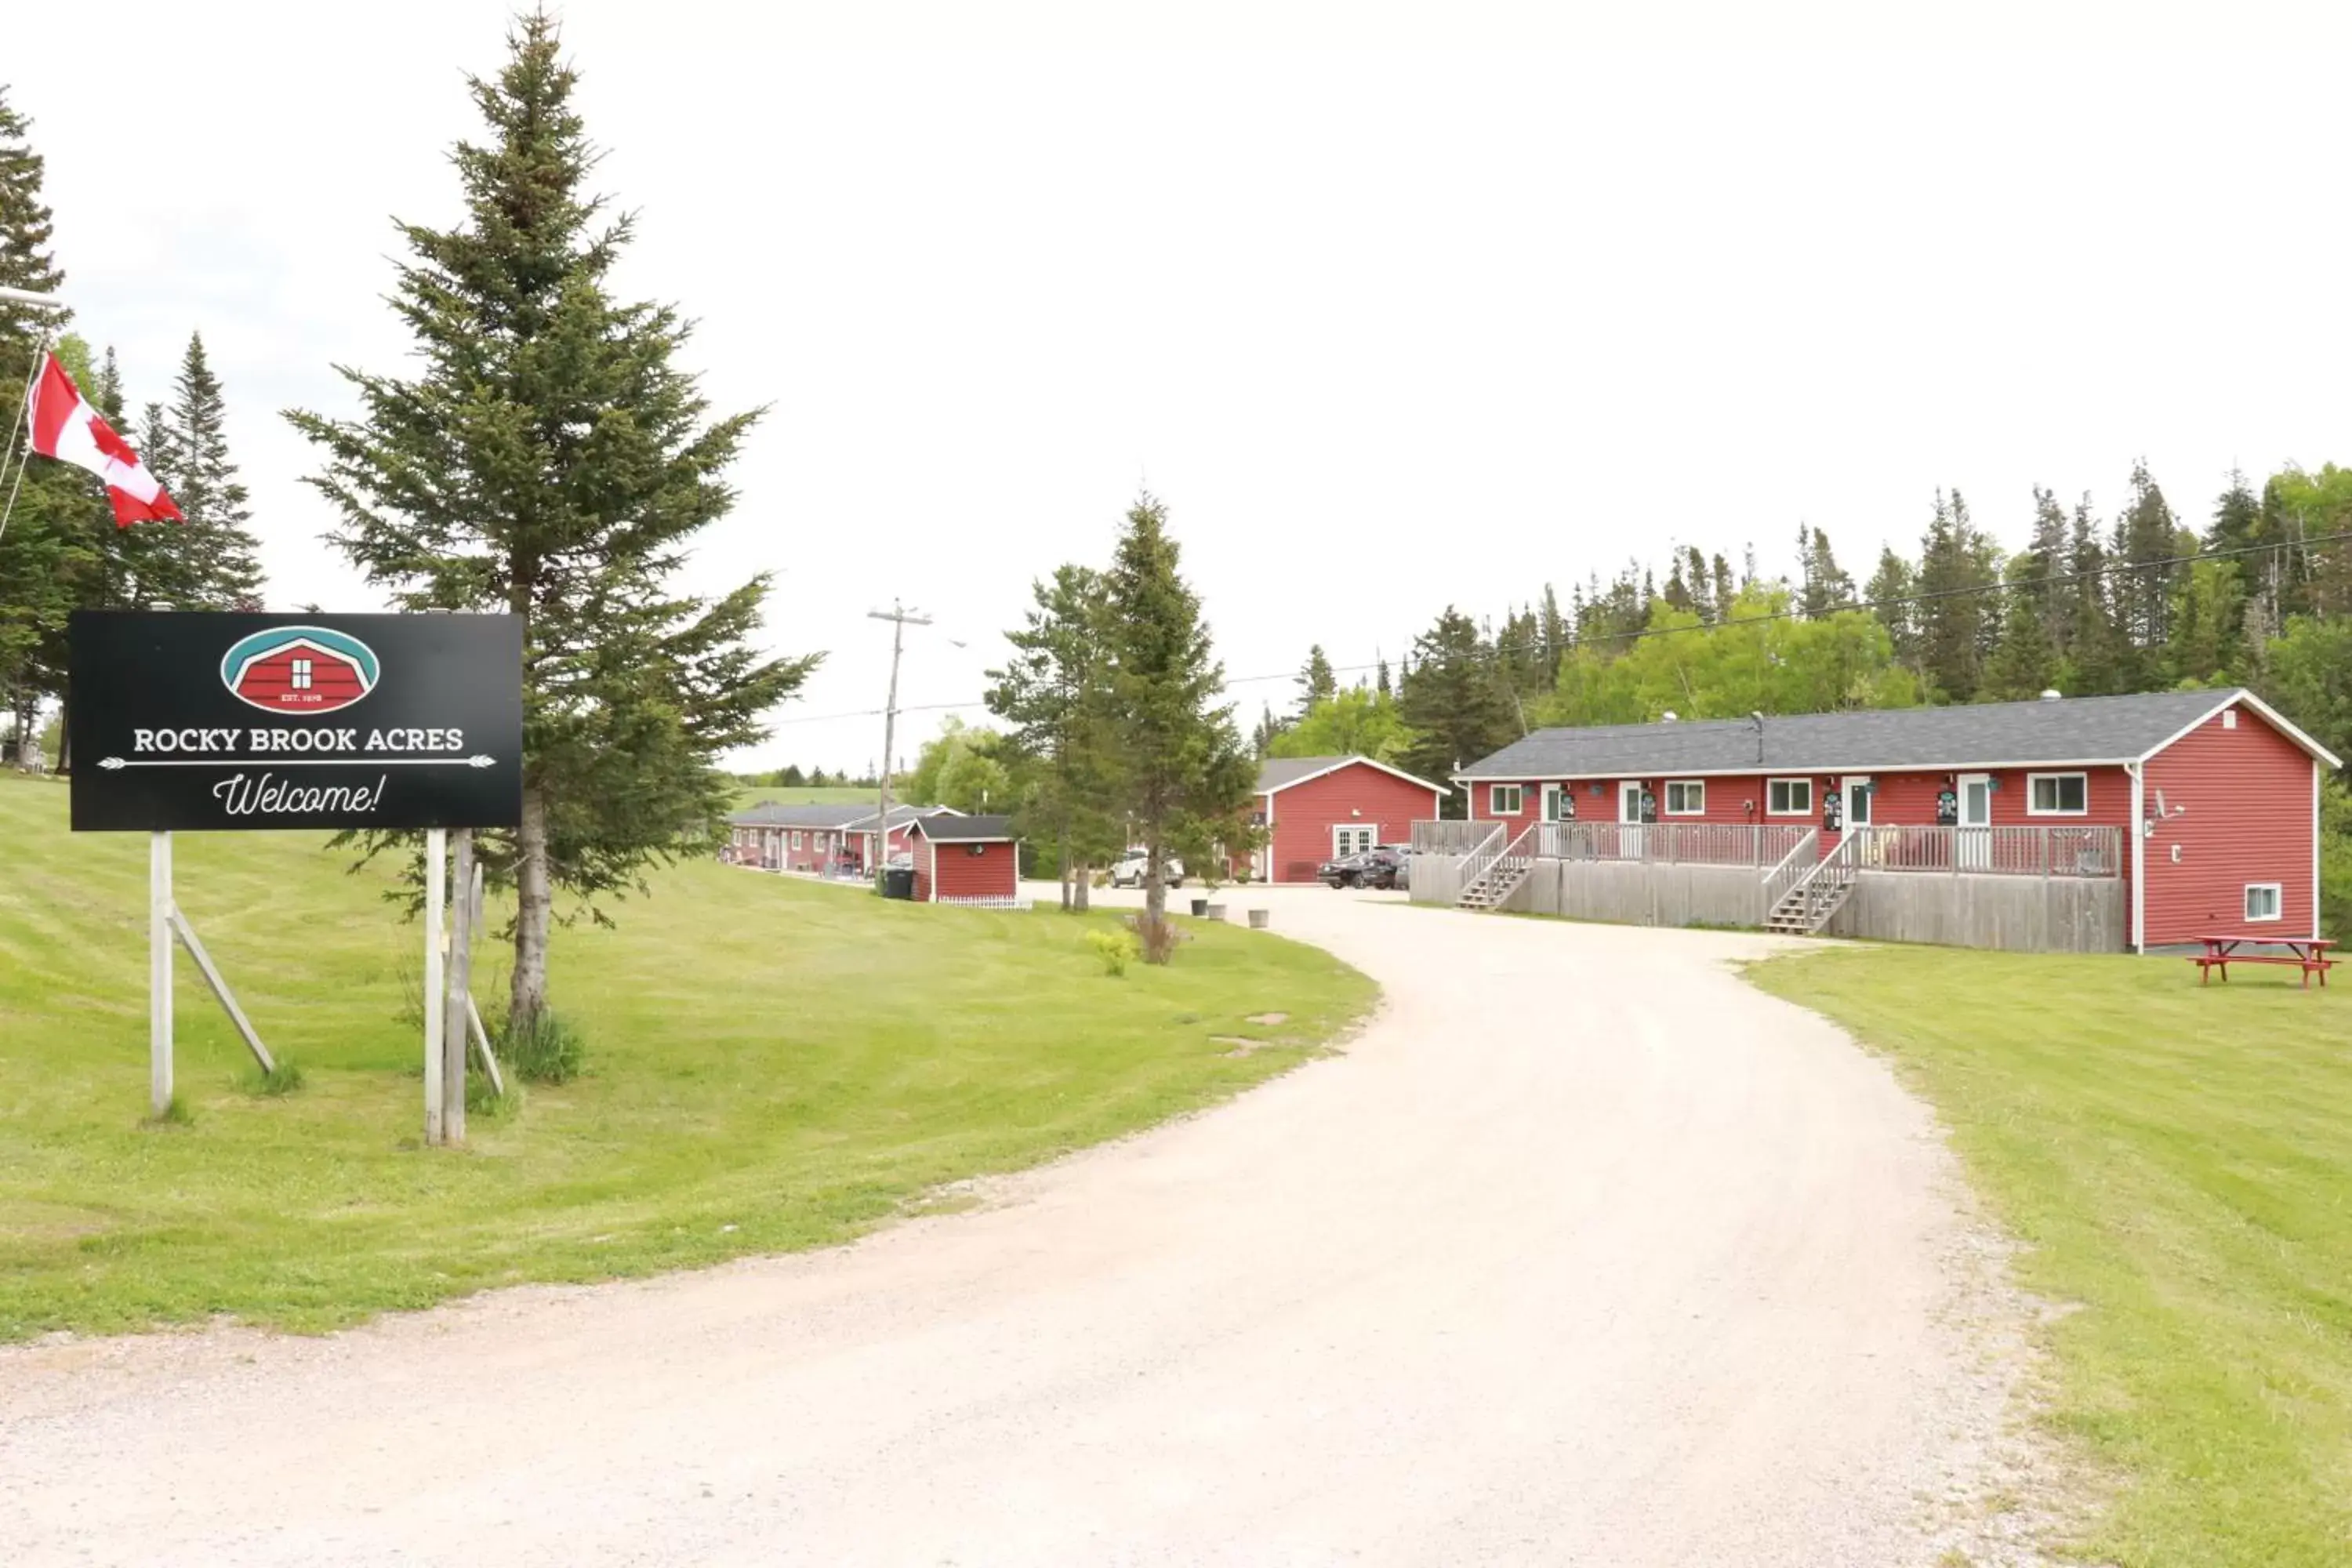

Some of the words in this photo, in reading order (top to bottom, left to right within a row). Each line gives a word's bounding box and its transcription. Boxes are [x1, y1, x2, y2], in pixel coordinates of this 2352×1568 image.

[134, 729, 241, 752] ROCKY
[249, 729, 357, 752] BROOK
[365, 728, 464, 751] ACRES
[212, 773, 387, 815] Welcome!
